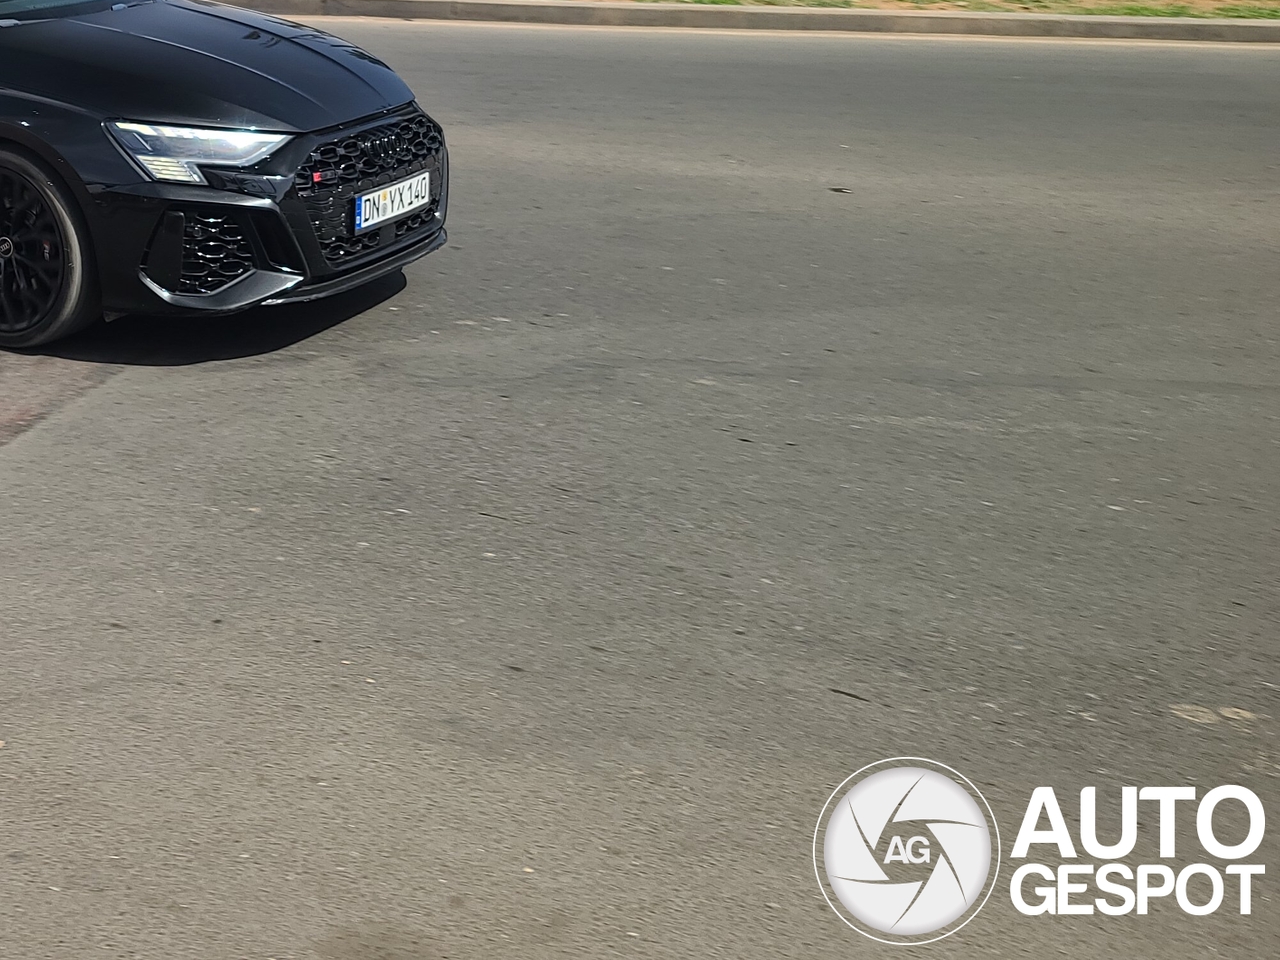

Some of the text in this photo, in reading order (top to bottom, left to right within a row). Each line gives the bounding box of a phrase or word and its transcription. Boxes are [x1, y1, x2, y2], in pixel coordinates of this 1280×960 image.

[363, 176, 427, 223] DN YX 140
